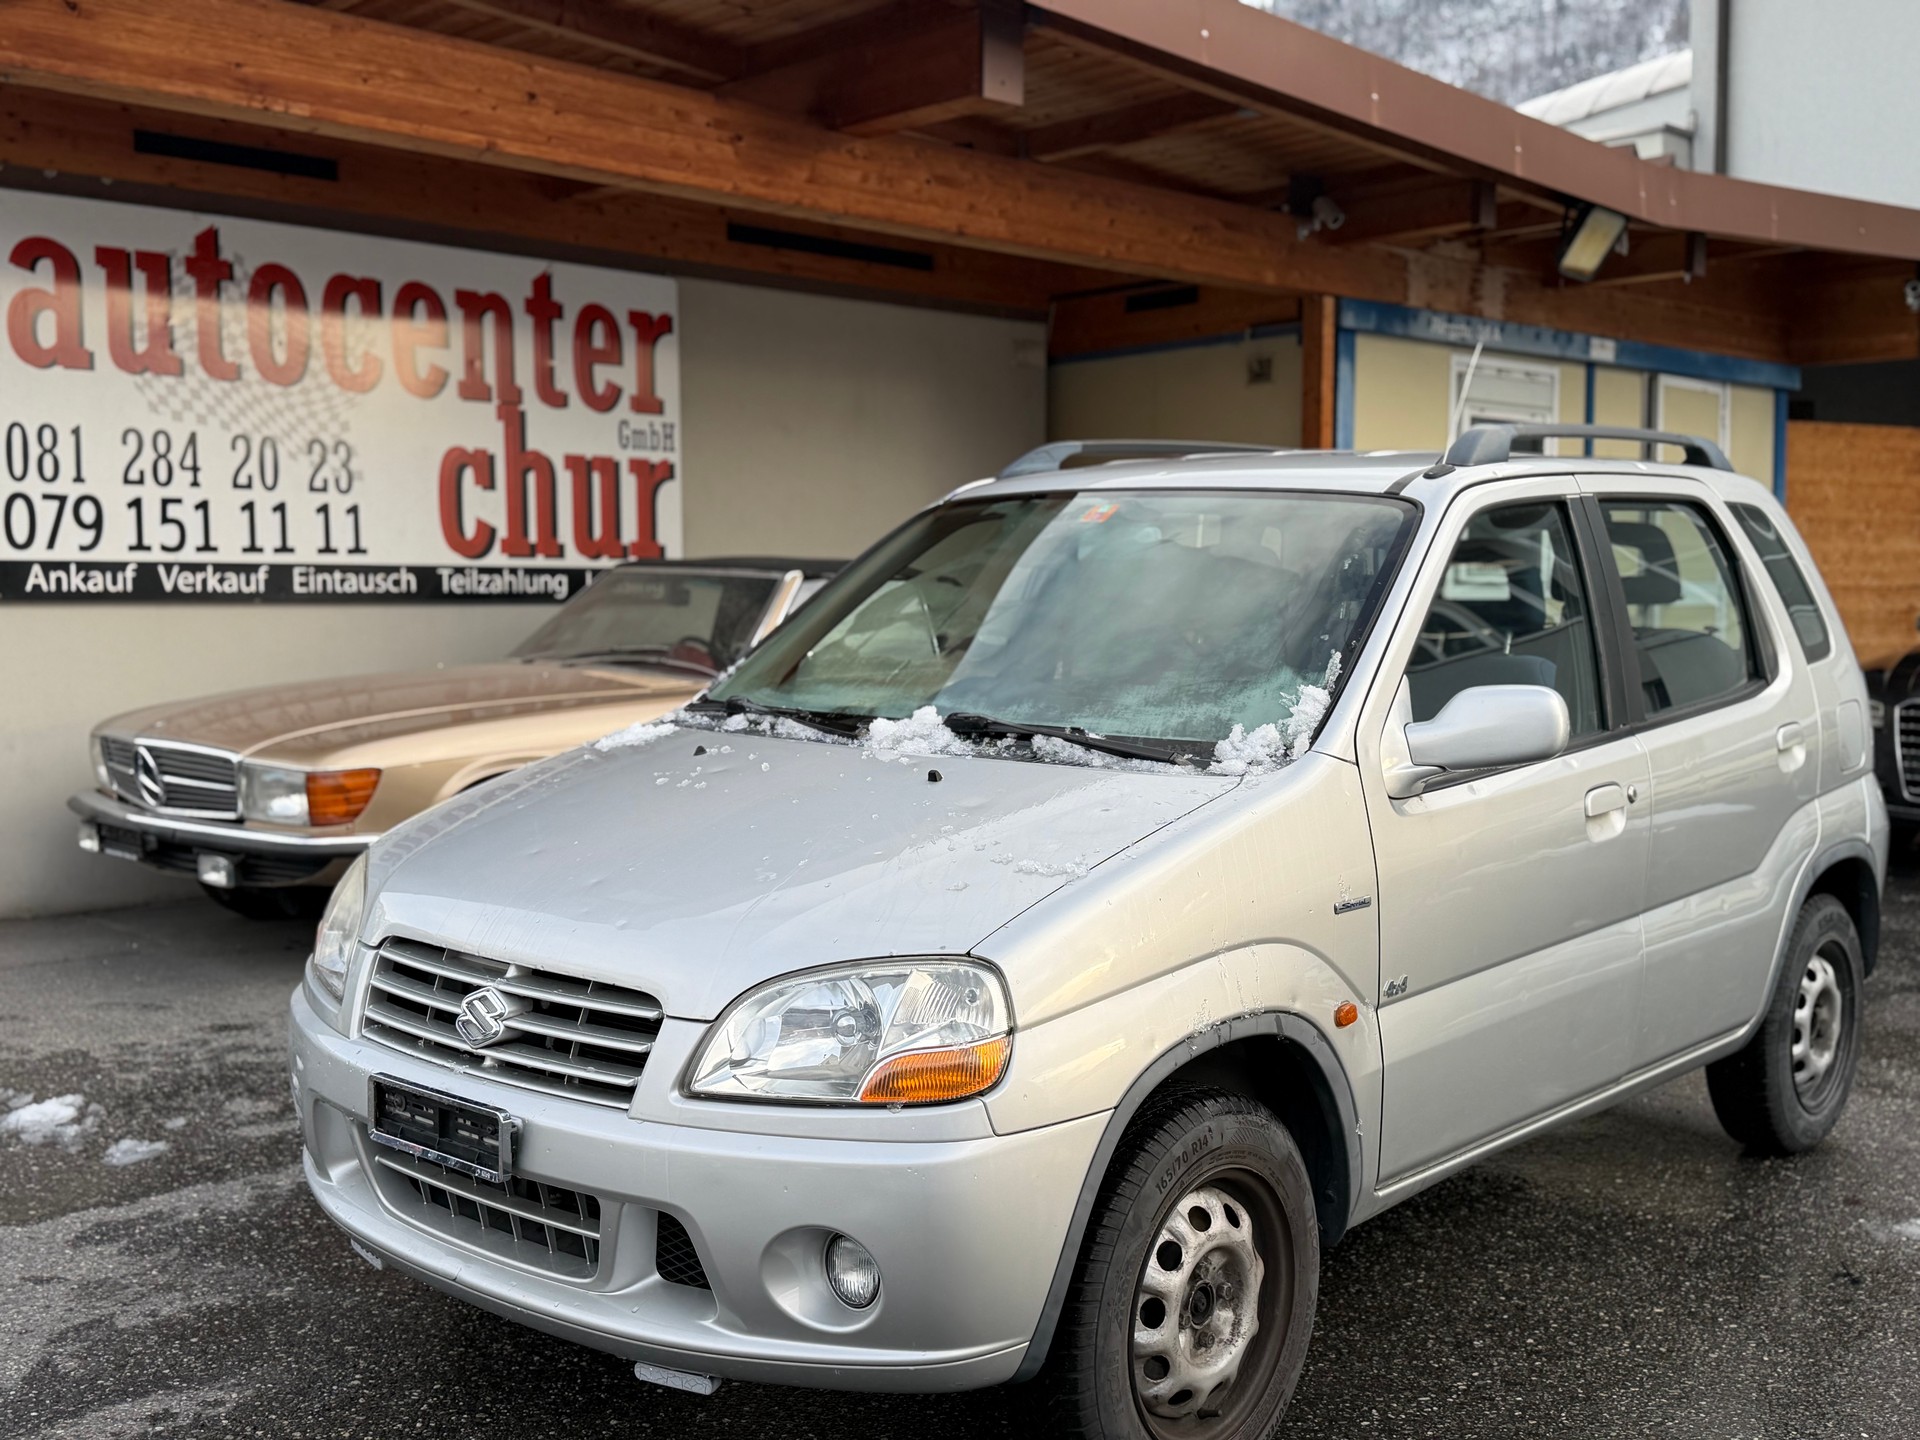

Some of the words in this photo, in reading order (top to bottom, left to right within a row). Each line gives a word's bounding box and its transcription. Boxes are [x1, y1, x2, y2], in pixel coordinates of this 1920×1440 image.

[7, 224, 673, 416] autocenter
[6, 422, 85, 484] 081
[121, 428, 201, 488] 284
[231, 434, 279, 492] 20
[308, 438, 355, 494] 23
[618, 420, 676, 453] GmbH
[439, 402, 675, 560] chur
[4, 492, 104, 552] 079
[126, 497, 218, 553] 151
[240, 501, 295, 553] 11
[315, 503, 367, 554] 11
[24, 562, 138, 594] Ankauf
[157, 564, 270, 595] Verkauf
[292, 566, 418, 595] Eintausch
[436, 567, 569, 600] Teilzahlung
[1155, 1151, 1189, 1195] 165/70
[1191, 1134, 1209, 1156] R14
